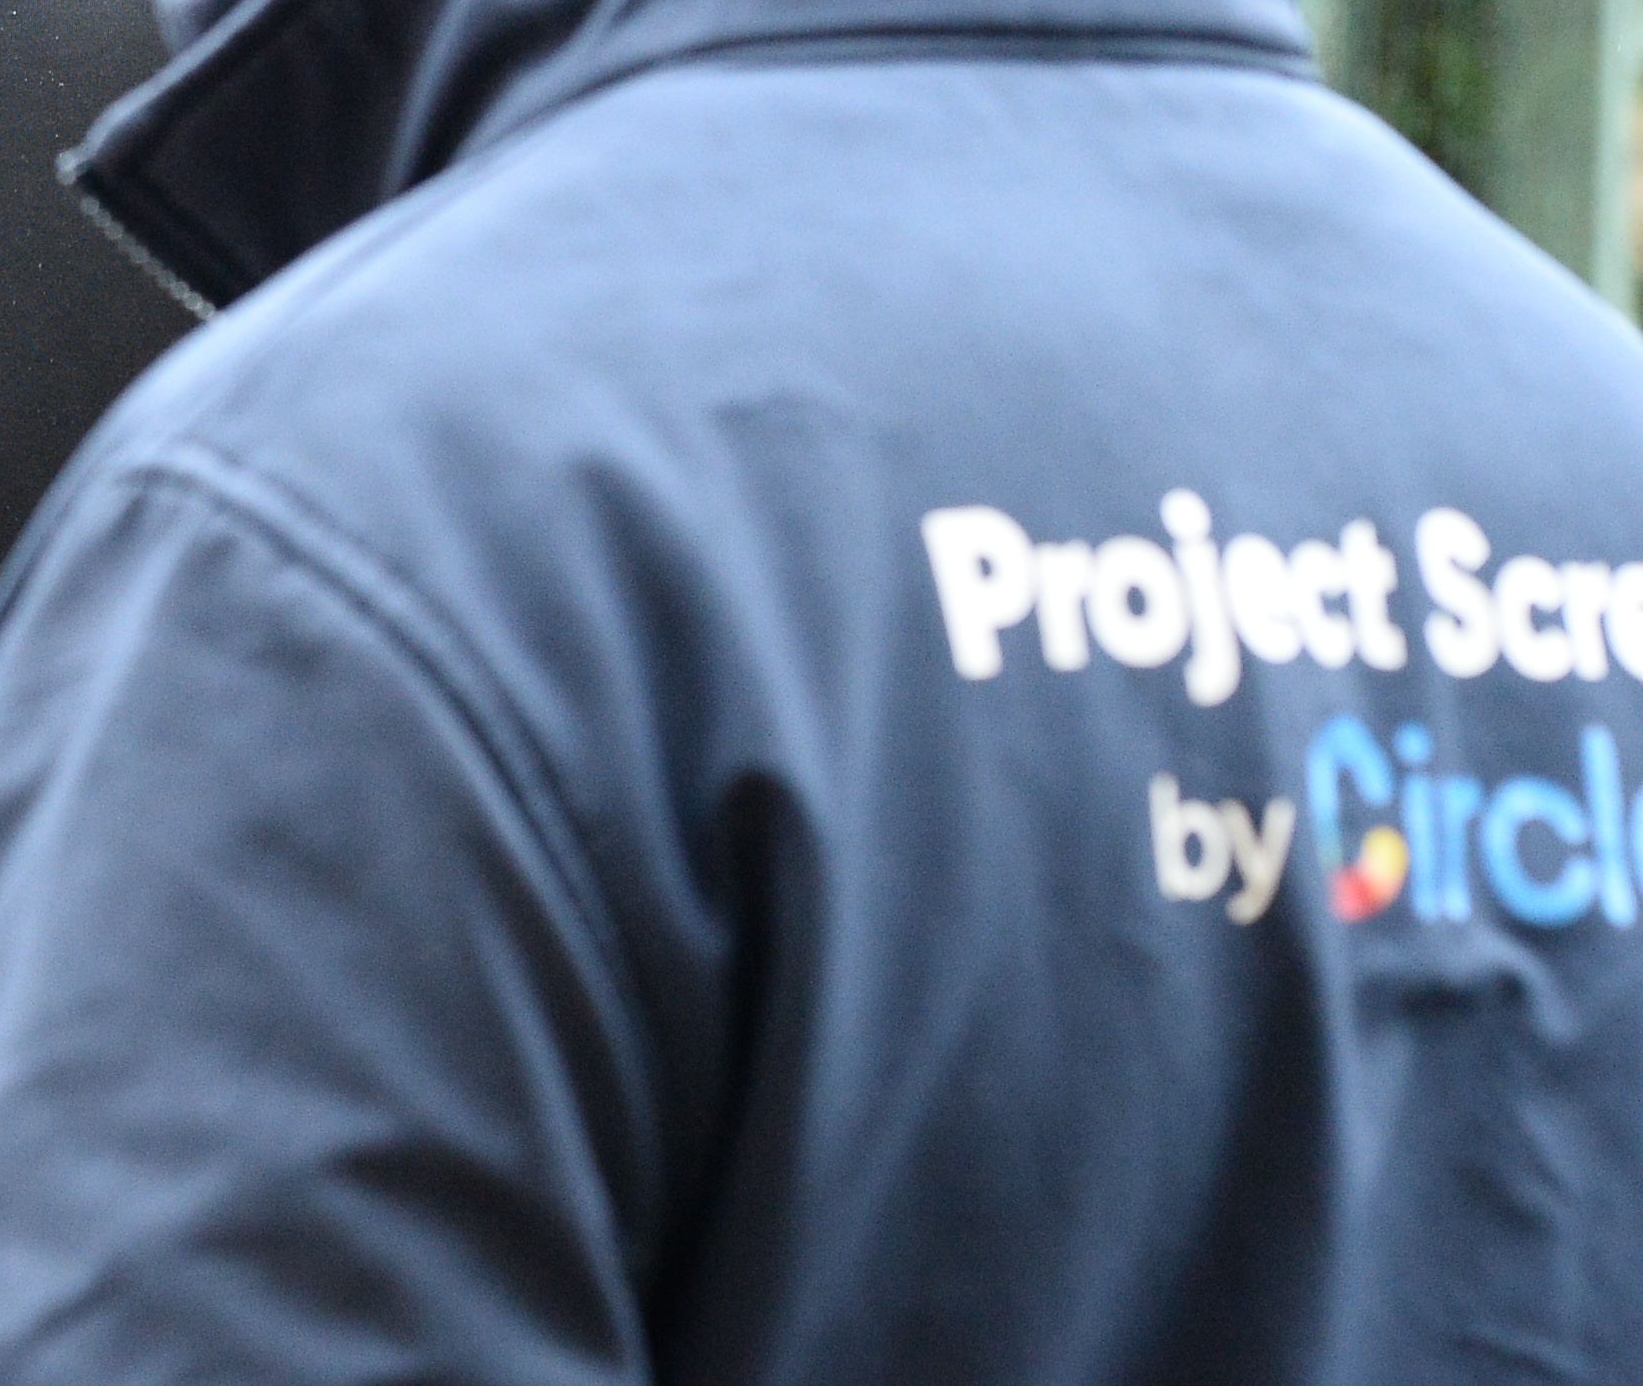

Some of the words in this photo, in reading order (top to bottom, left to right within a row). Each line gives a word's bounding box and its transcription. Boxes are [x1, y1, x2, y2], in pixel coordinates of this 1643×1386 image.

[920, 487, 1408, 706] Project
[1416, 507, 1643, 682] Scr
[1147, 771, 1297, 925] by
[1307, 714, 1643, 930] Circl
